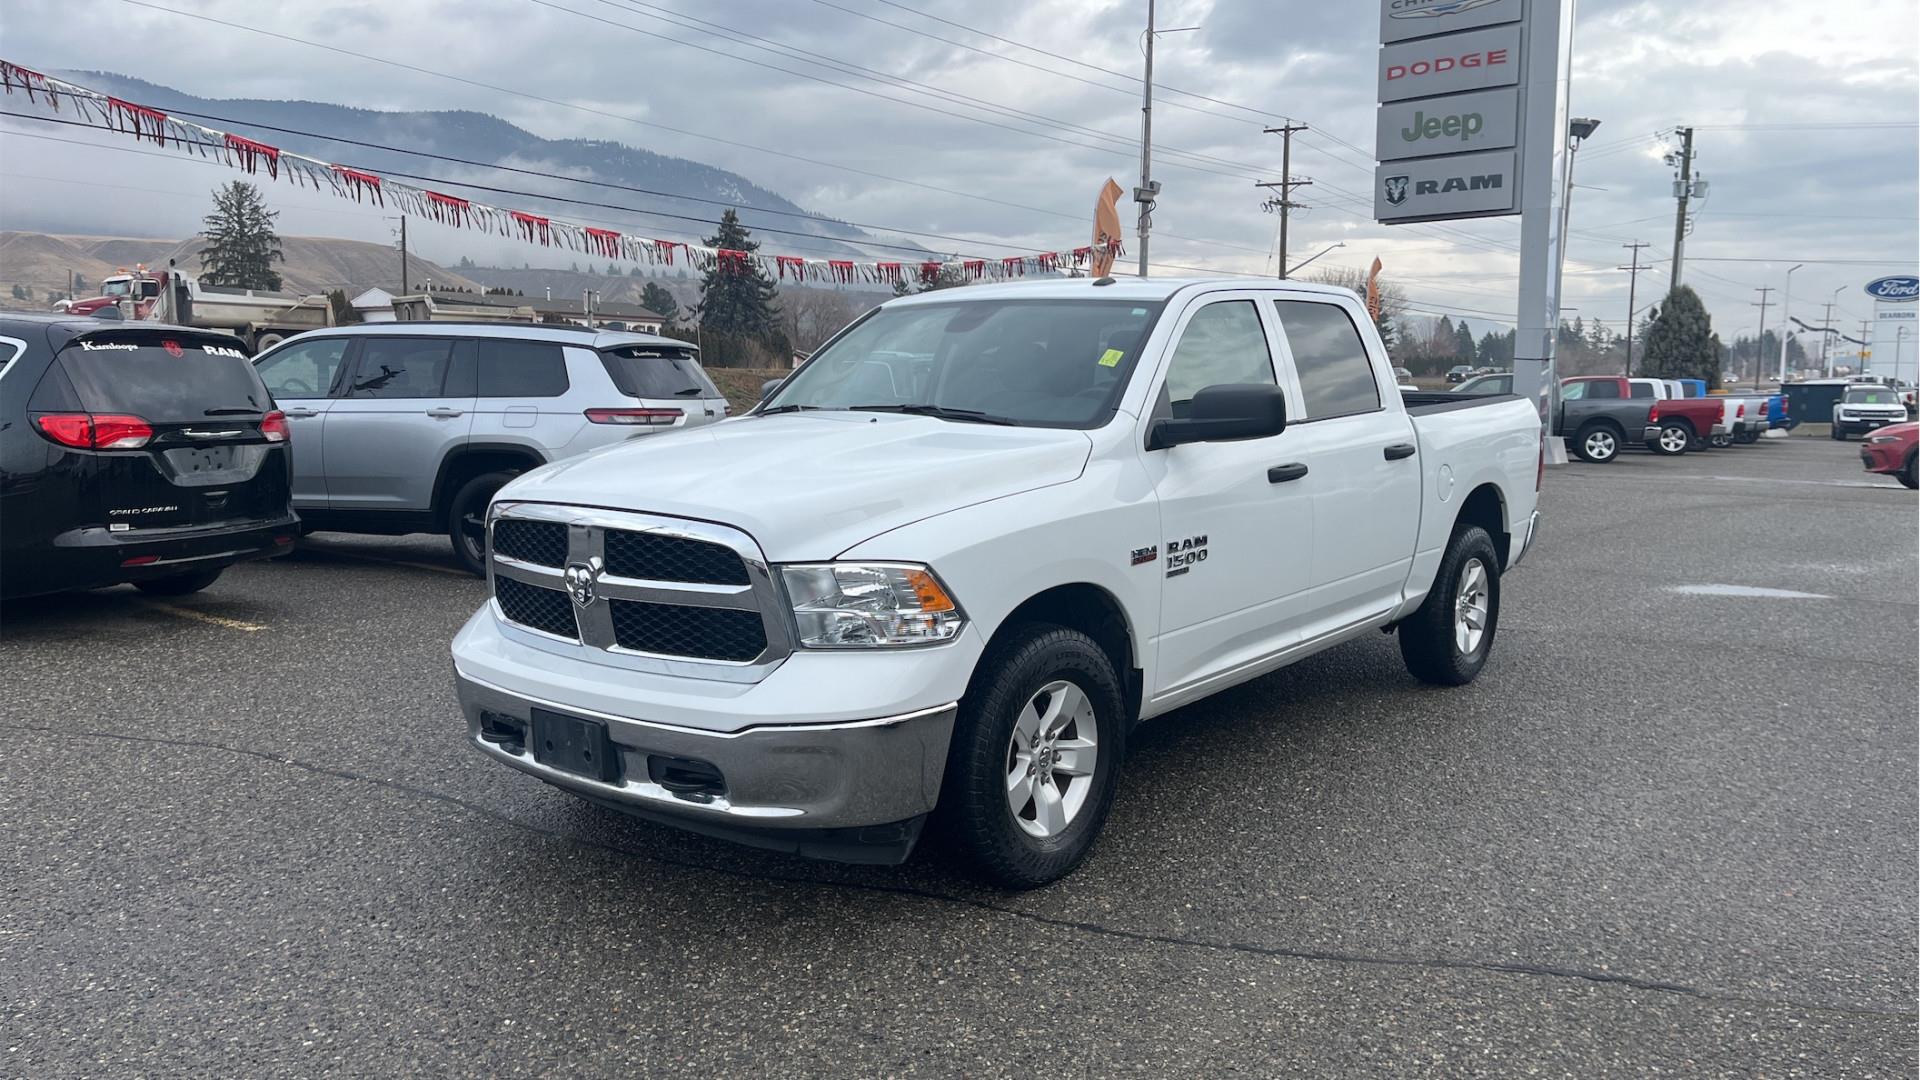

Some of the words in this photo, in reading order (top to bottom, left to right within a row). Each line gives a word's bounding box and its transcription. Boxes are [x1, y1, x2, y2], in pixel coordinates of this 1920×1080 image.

[1387, 49, 1507, 81] DODGE
[1401, 111, 1483, 142] Jeep
[1415, 174, 1503, 195] RAM
[1877, 279, 1919, 296] Ford
[79, 340, 138, 352] Kamloops
[202, 345, 244, 360] RAM
[1166, 534, 1208, 555] RAM
[1166, 548, 1208, 569] 1500
